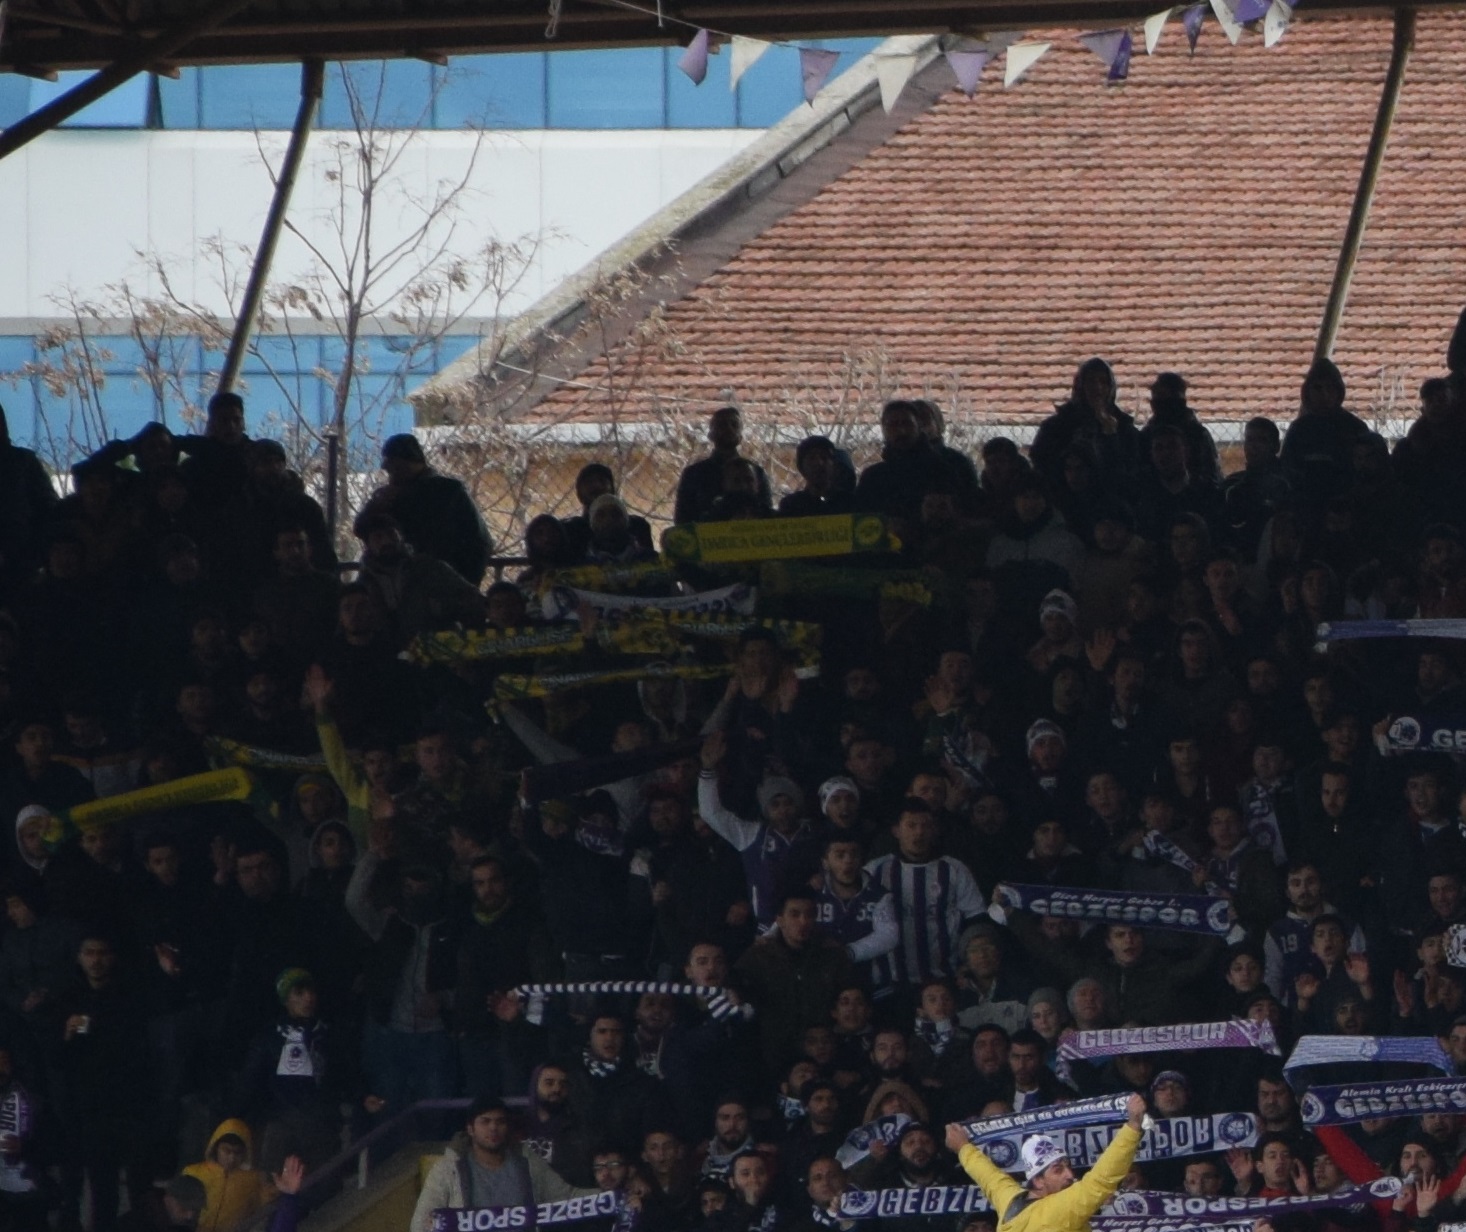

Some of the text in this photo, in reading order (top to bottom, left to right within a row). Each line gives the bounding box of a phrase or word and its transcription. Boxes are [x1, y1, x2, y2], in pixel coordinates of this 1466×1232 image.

[1030, 901, 1200, 926] GEBZESPOR
[1078, 1022, 1227, 1049] GEBZESPOR
[457, 1190, 616, 1232] GEBZE SPOR
